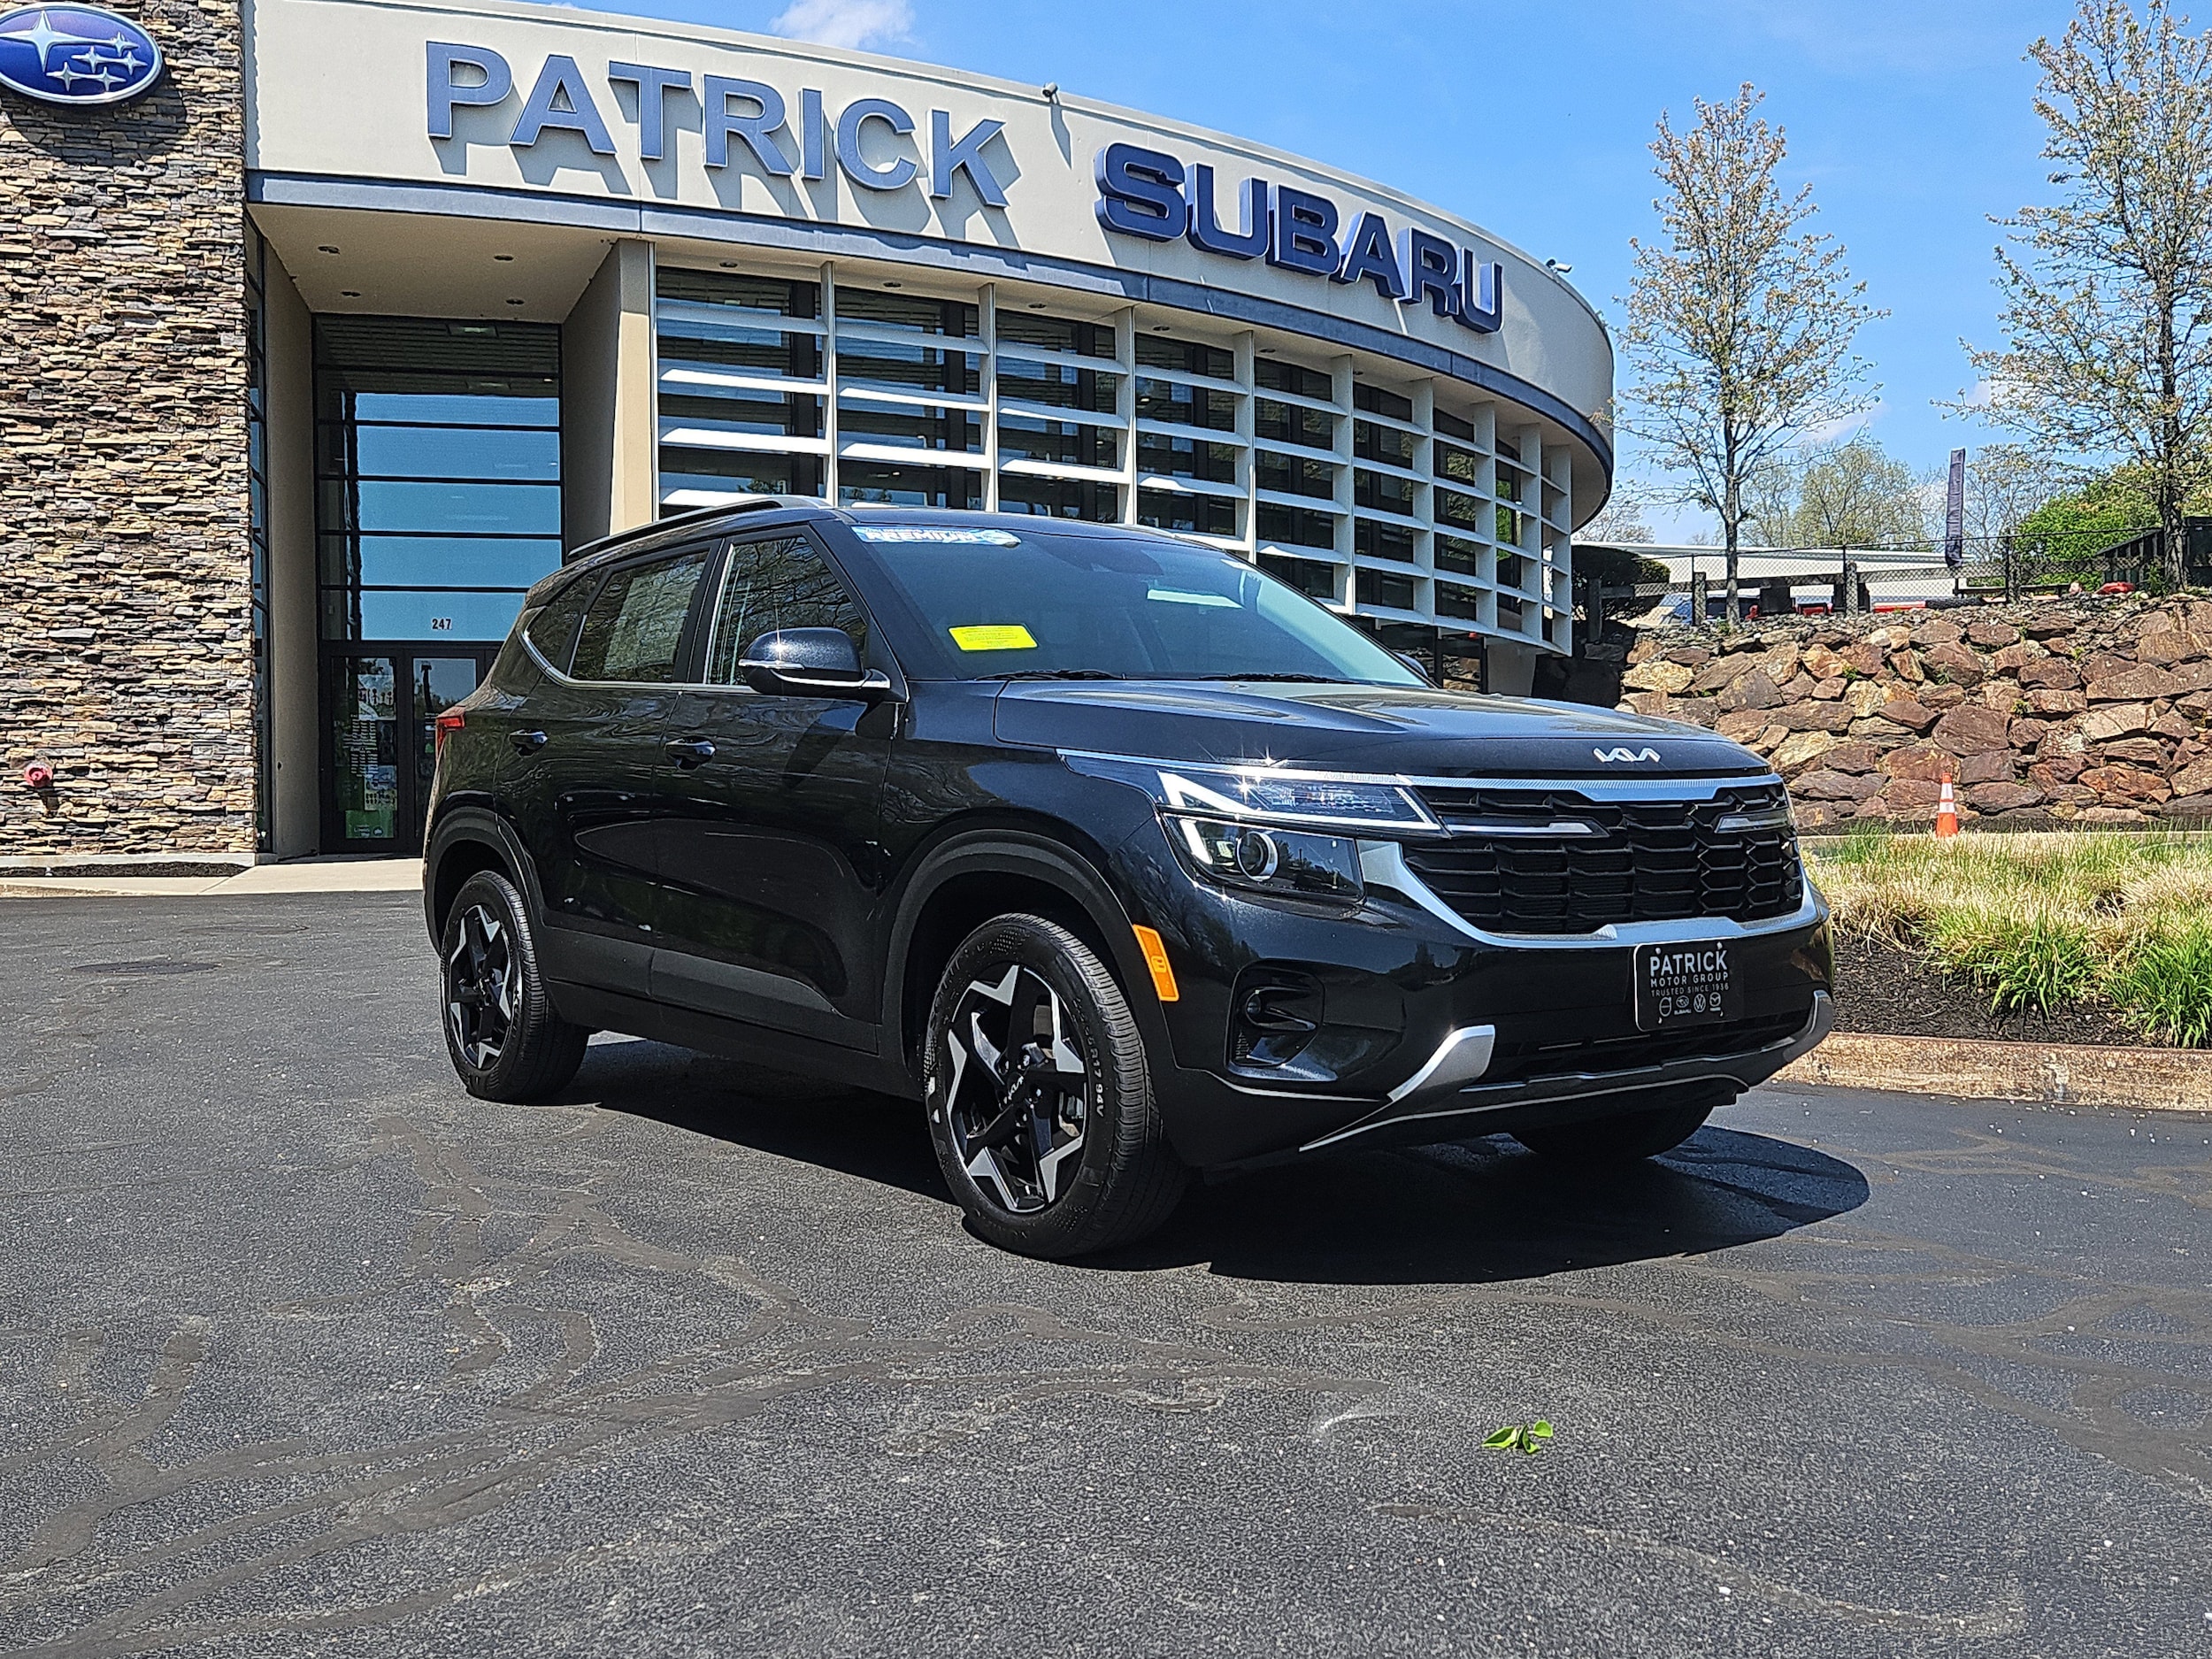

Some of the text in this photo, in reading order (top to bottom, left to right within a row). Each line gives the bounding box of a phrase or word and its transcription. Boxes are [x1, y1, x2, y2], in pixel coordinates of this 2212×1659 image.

[426, 40, 1504, 334] PATRICK SUBARU
[432, 618, 451, 629] 247
[1594, 747, 1661, 763] KIA
[1650, 949, 1727, 977] PATRICK
[1650, 972, 1729, 988] MOTOR GROUP
[1651, 987, 1685, 997] TRUSTED
[1687, 984, 1709, 994] SINCE
